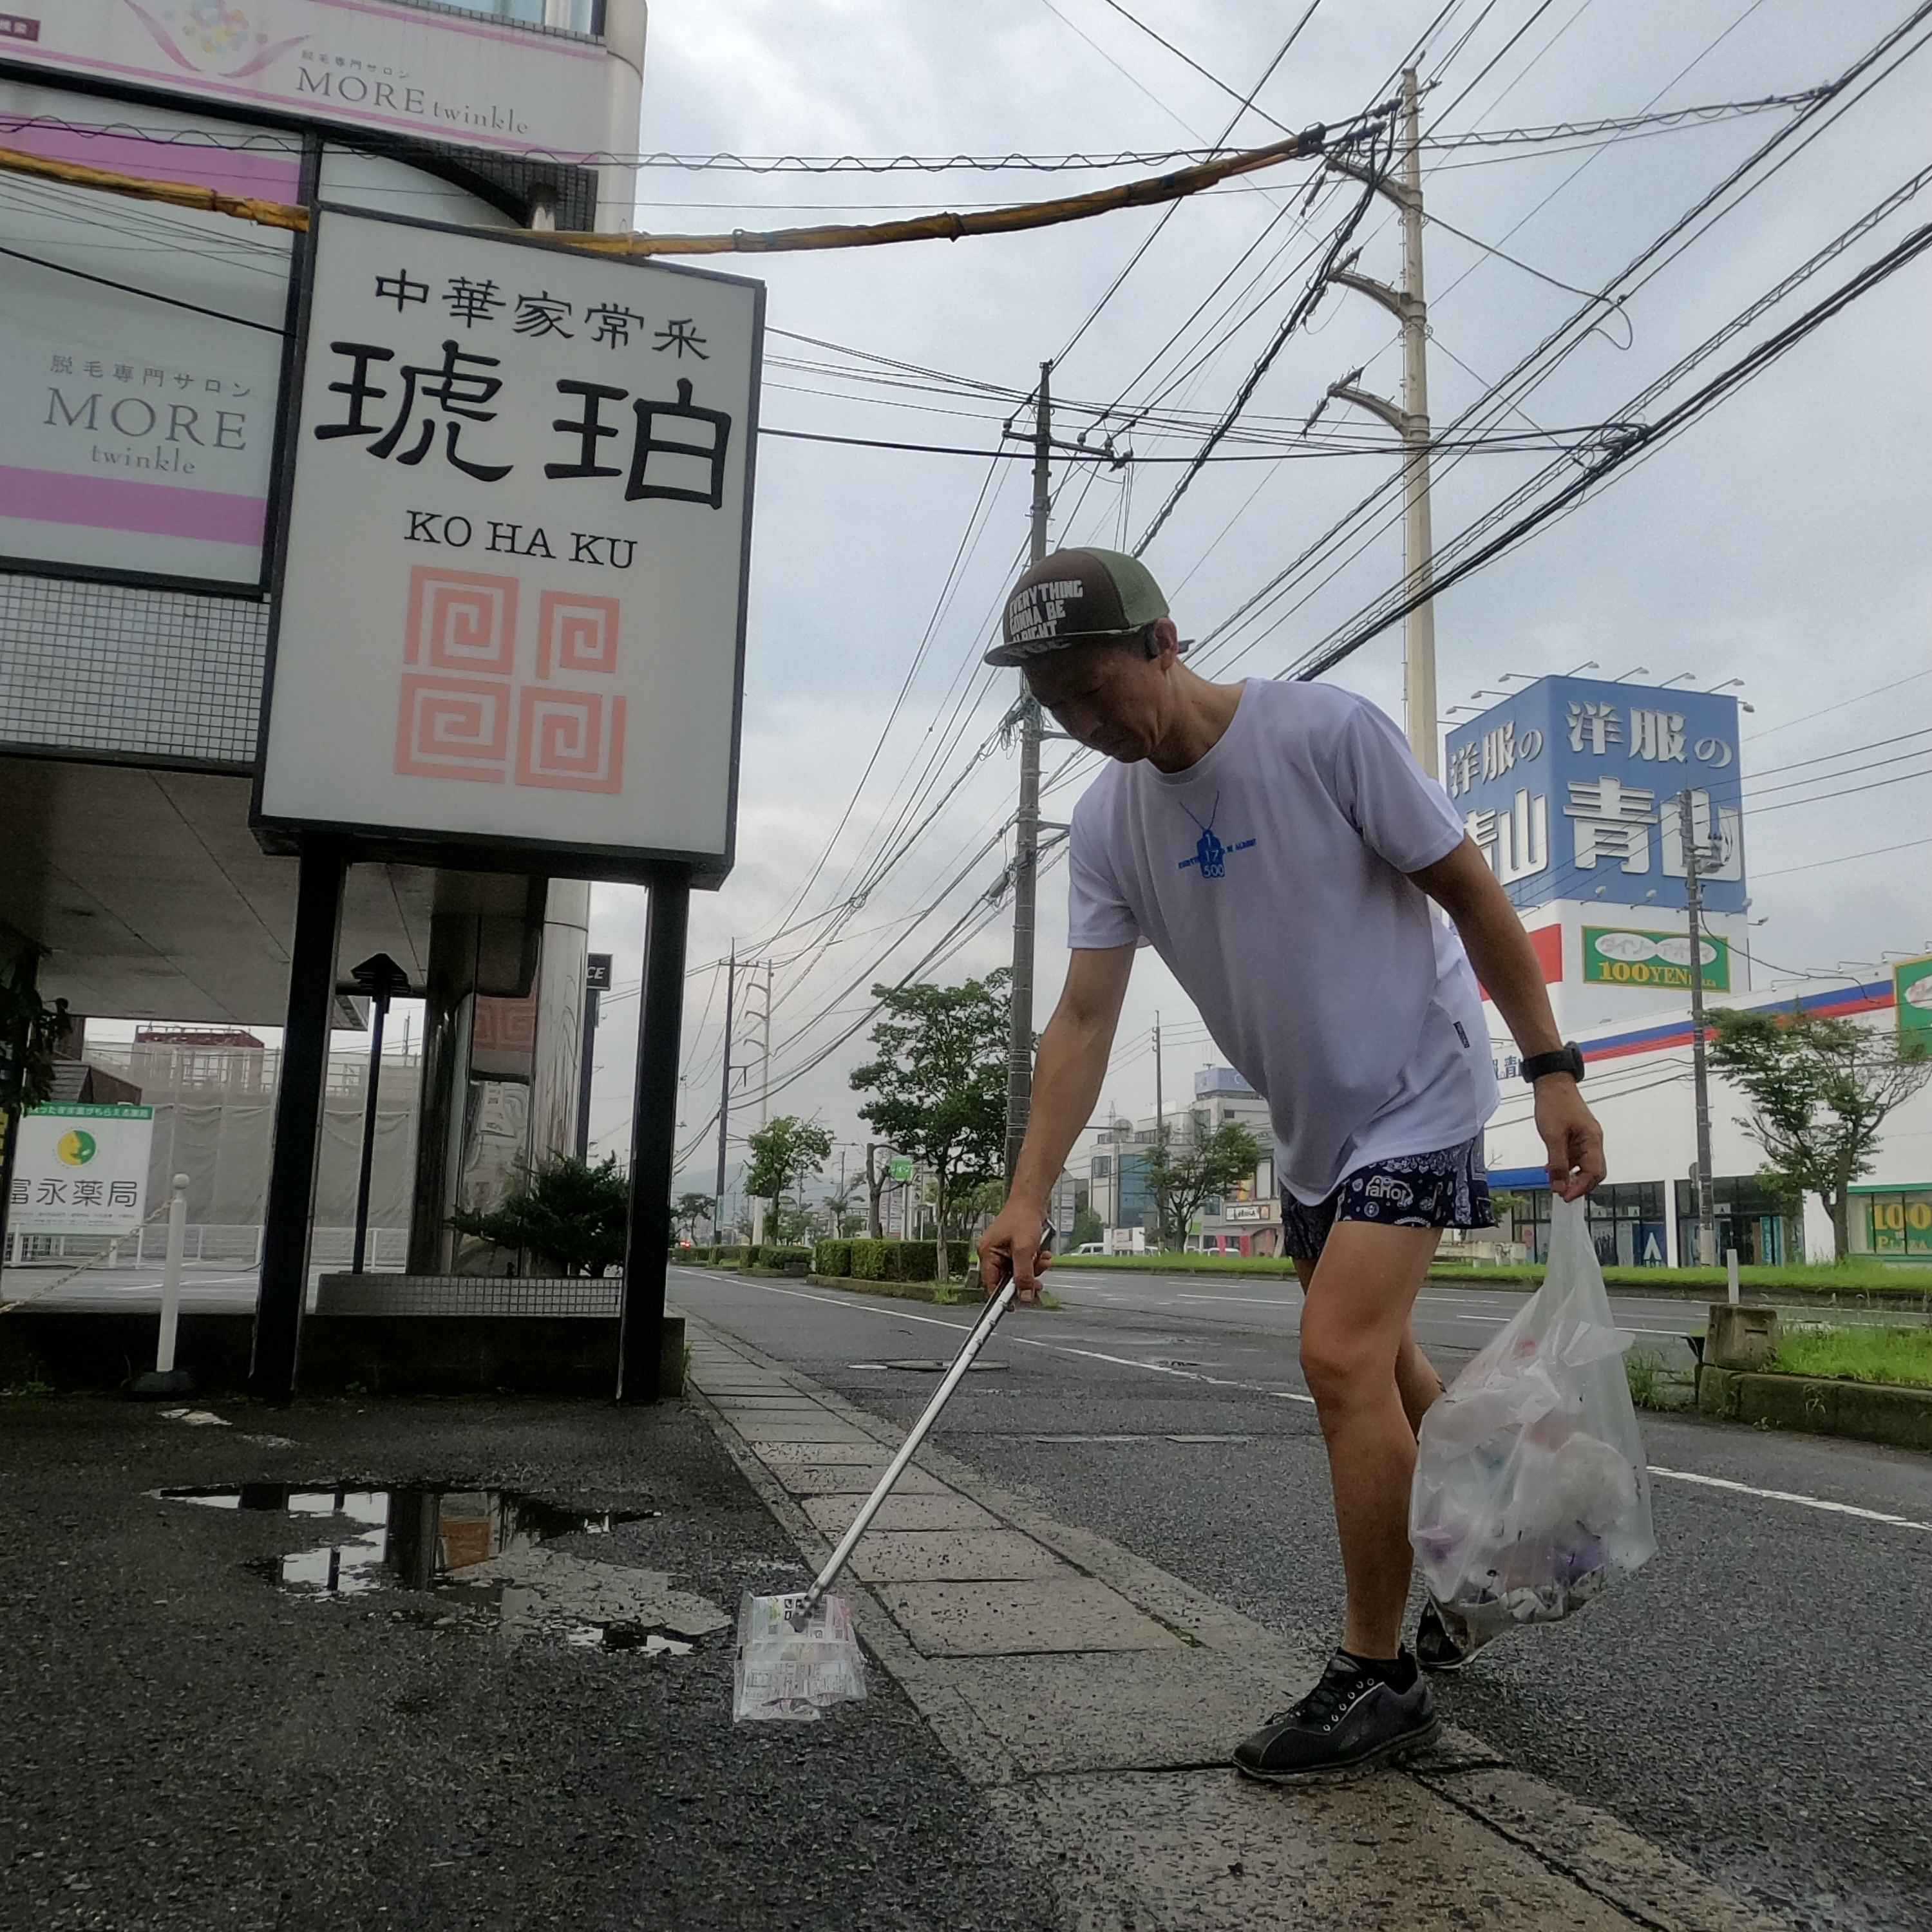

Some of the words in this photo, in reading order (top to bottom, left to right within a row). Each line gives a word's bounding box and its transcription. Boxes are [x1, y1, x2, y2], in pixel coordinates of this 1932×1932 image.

[295, 66, 425, 115] MORE
[433, 101, 529, 135] twinkle
[50, 355, 251, 398] 脱毛専門サロン
[43, 387, 247, 451] MORE
[314, 339, 732, 510] 琥珀
[91, 444, 196, 474] twinkle
[1009, 605, 1043, 636] GONNA
[1045, 599, 1066, 620] BE
[1448, 719, 1543, 799] 洋服の
[1564, 700, 1733, 769] 洋服の
[1562, 775, 1742, 882] 青山
[1660, 943, 1712, 960] アオマ
